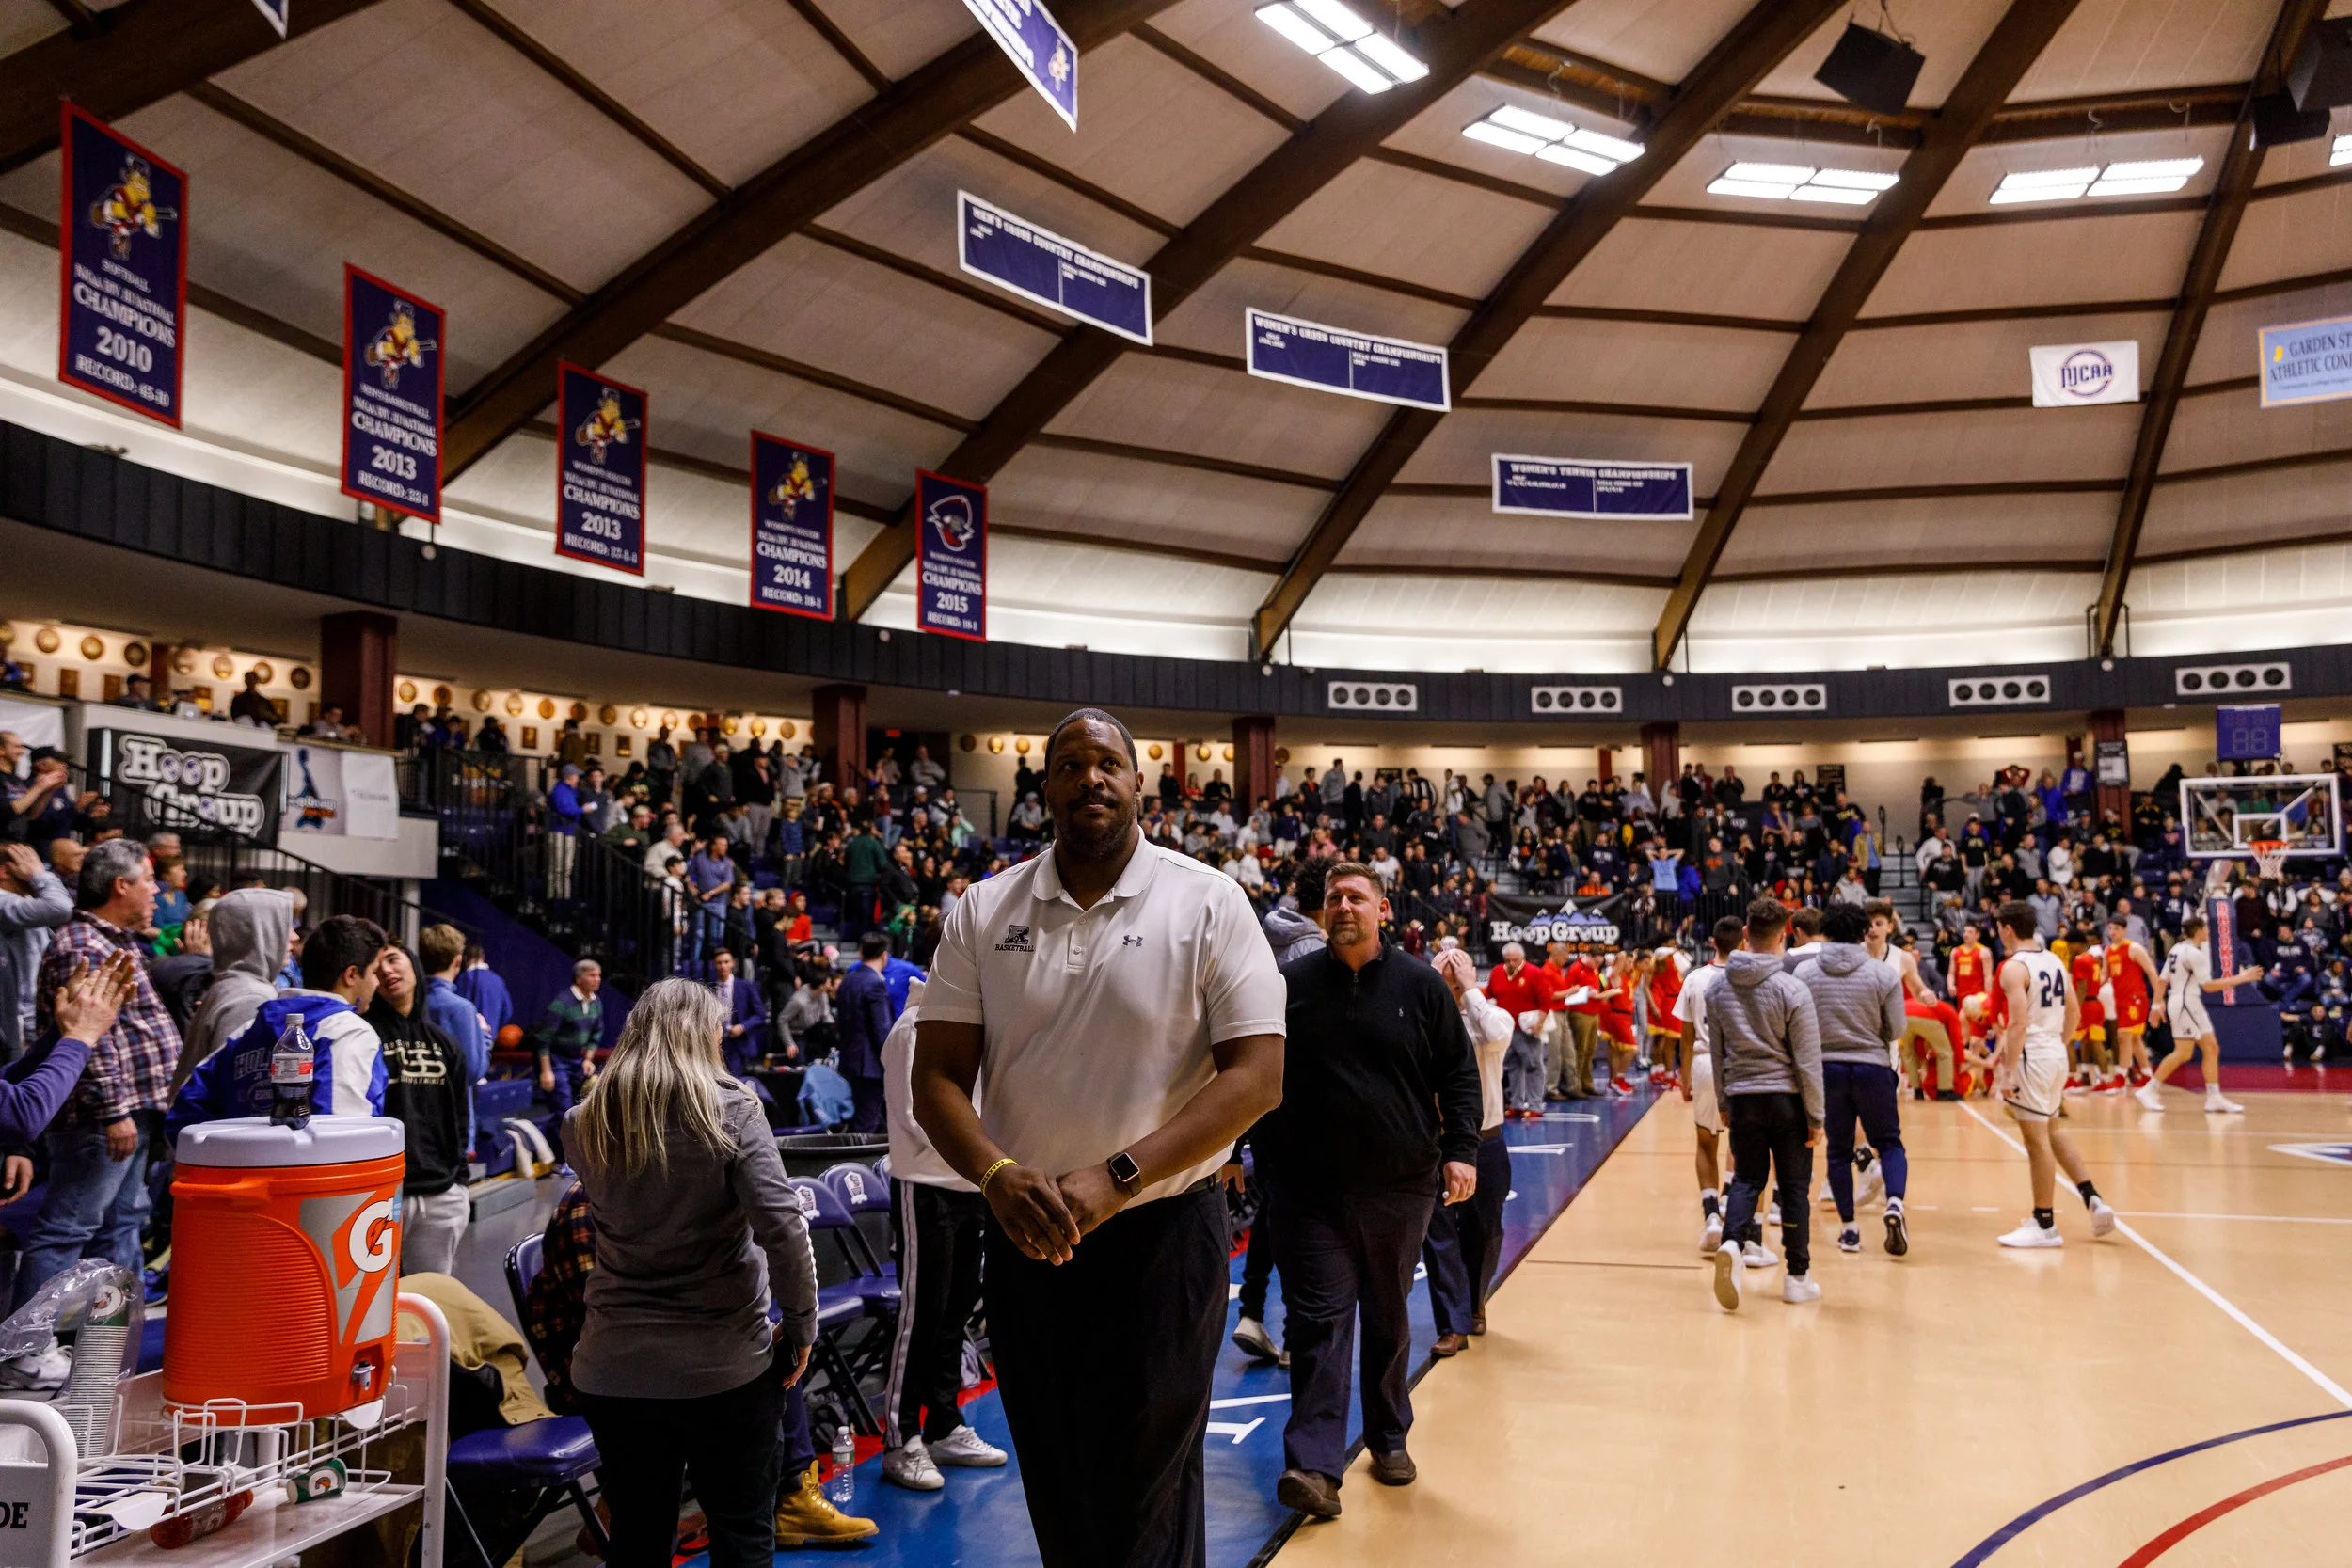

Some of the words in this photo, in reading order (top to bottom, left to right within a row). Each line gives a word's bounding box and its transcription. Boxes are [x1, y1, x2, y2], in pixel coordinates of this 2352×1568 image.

[73, 282, 176, 348] CHAMPIONS
[96, 325, 153, 373] 2010
[1254, 315, 1298, 336] WOMEN'S
[1329, 334, 1372, 352] COUNTRY
[1373, 342, 1442, 365] CHAMPIONSHIPS
[2289, 335, 2336, 357] GARDEN
[2061, 364, 2113, 388] NJCAA
[2270, 356, 2323, 382] ATHLETIC
[351, 411, 437, 457] CHAMPIONS
[371, 444, 417, 481] 2013
[1510, 463, 1557, 476] WOMEN'S
[1559, 466, 1597, 479] TENNIS
[1598, 468, 1677, 481] CHAMPIONSHIPS
[563, 483, 640, 520] CHAMPIONS
[580, 511, 622, 540] 2013
[756, 541, 828, 570] CHAMPIONS
[773, 564, 812, 590] 2014
[922, 570, 983, 596] CHAMPIONS
[936, 591, 969, 613] 2015
[119, 735, 230, 794] Hoop
[144, 784, 264, 836] Group
[994, 943, 1034, 952] BASKETBALL
[1490, 921, 1550, 946] Hoop
[1551, 921, 1620, 945] Group
[2039, 969, 2065, 1008] 24
[349, 1197, 393, 1273] G
